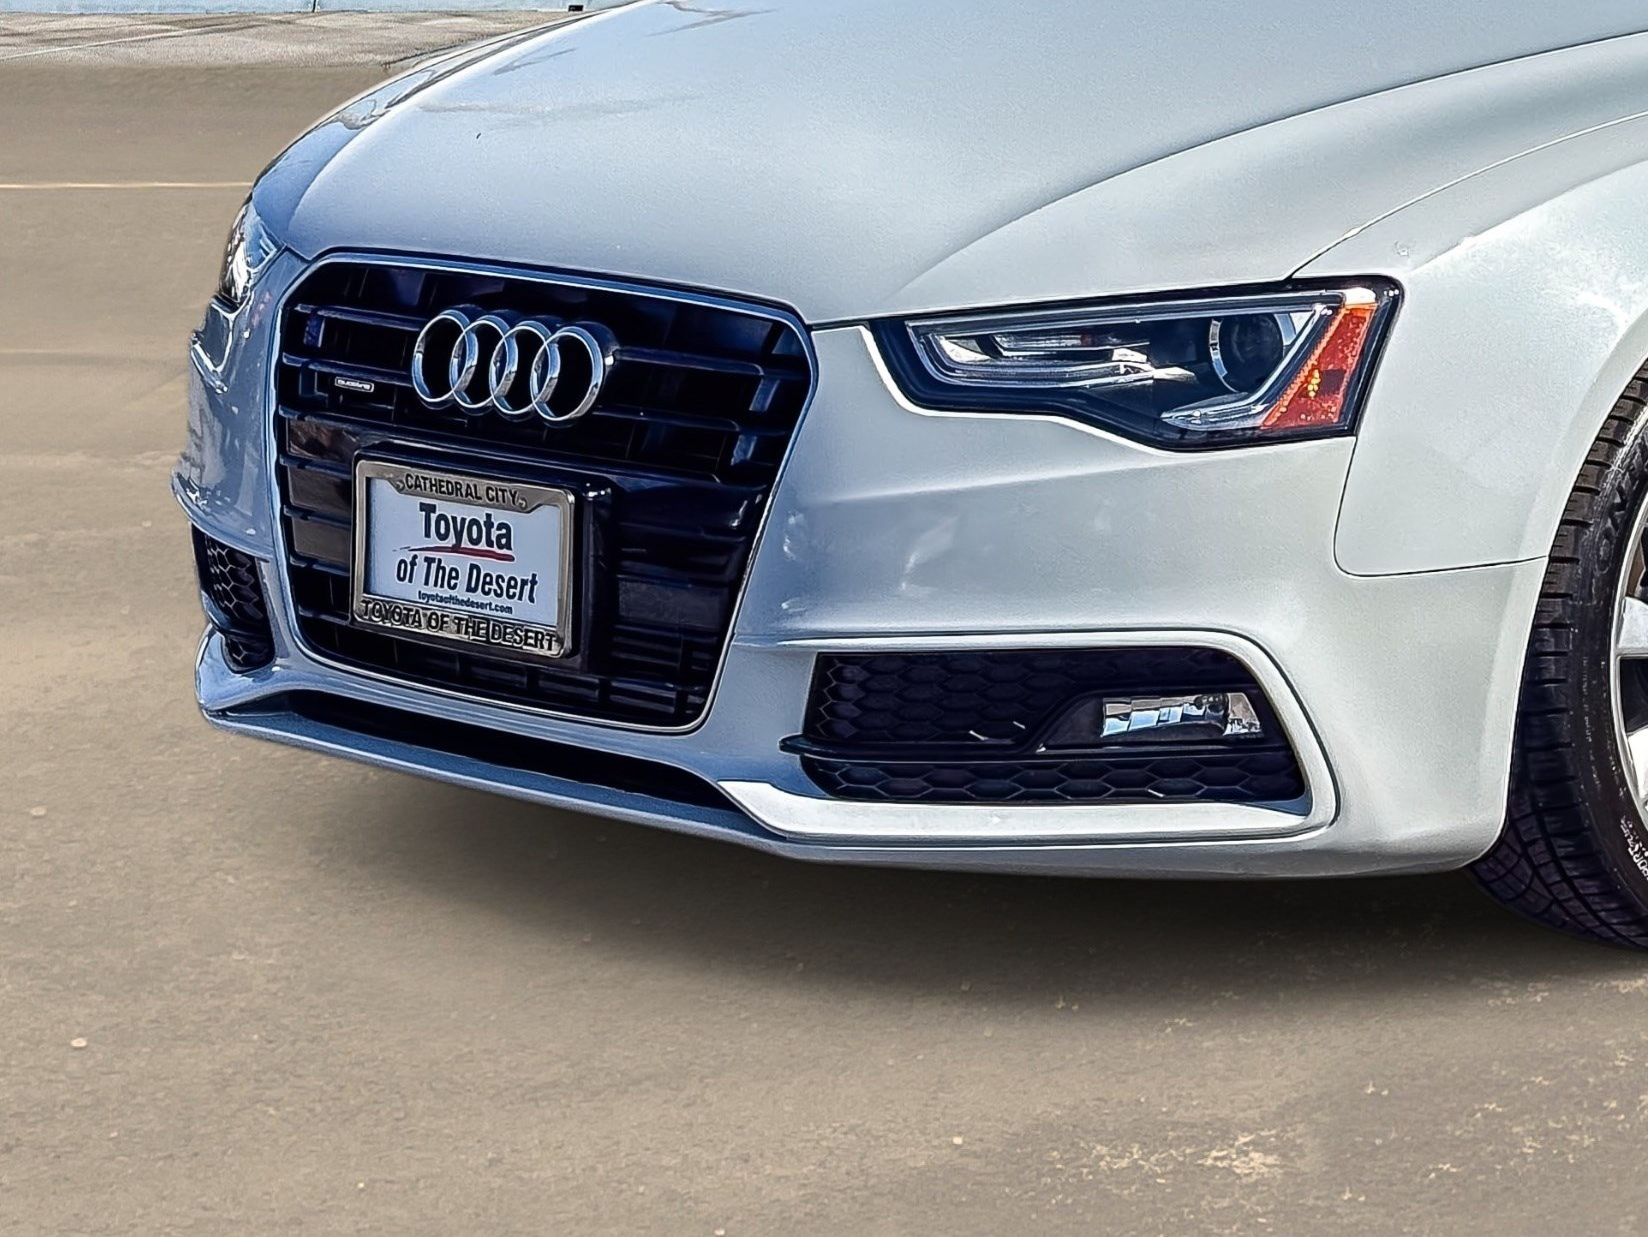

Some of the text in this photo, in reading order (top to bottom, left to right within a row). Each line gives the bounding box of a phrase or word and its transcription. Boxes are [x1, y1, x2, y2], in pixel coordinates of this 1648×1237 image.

[404, 473, 518, 506] CATHEDRAL CITY
[419, 502, 513, 552] Toyota
[396, 554, 539, 604] of The Desert
[418, 590, 513, 614] toyotaofthedesert.com
[361, 600, 557, 651] TOYOTA OF THE DESERT
